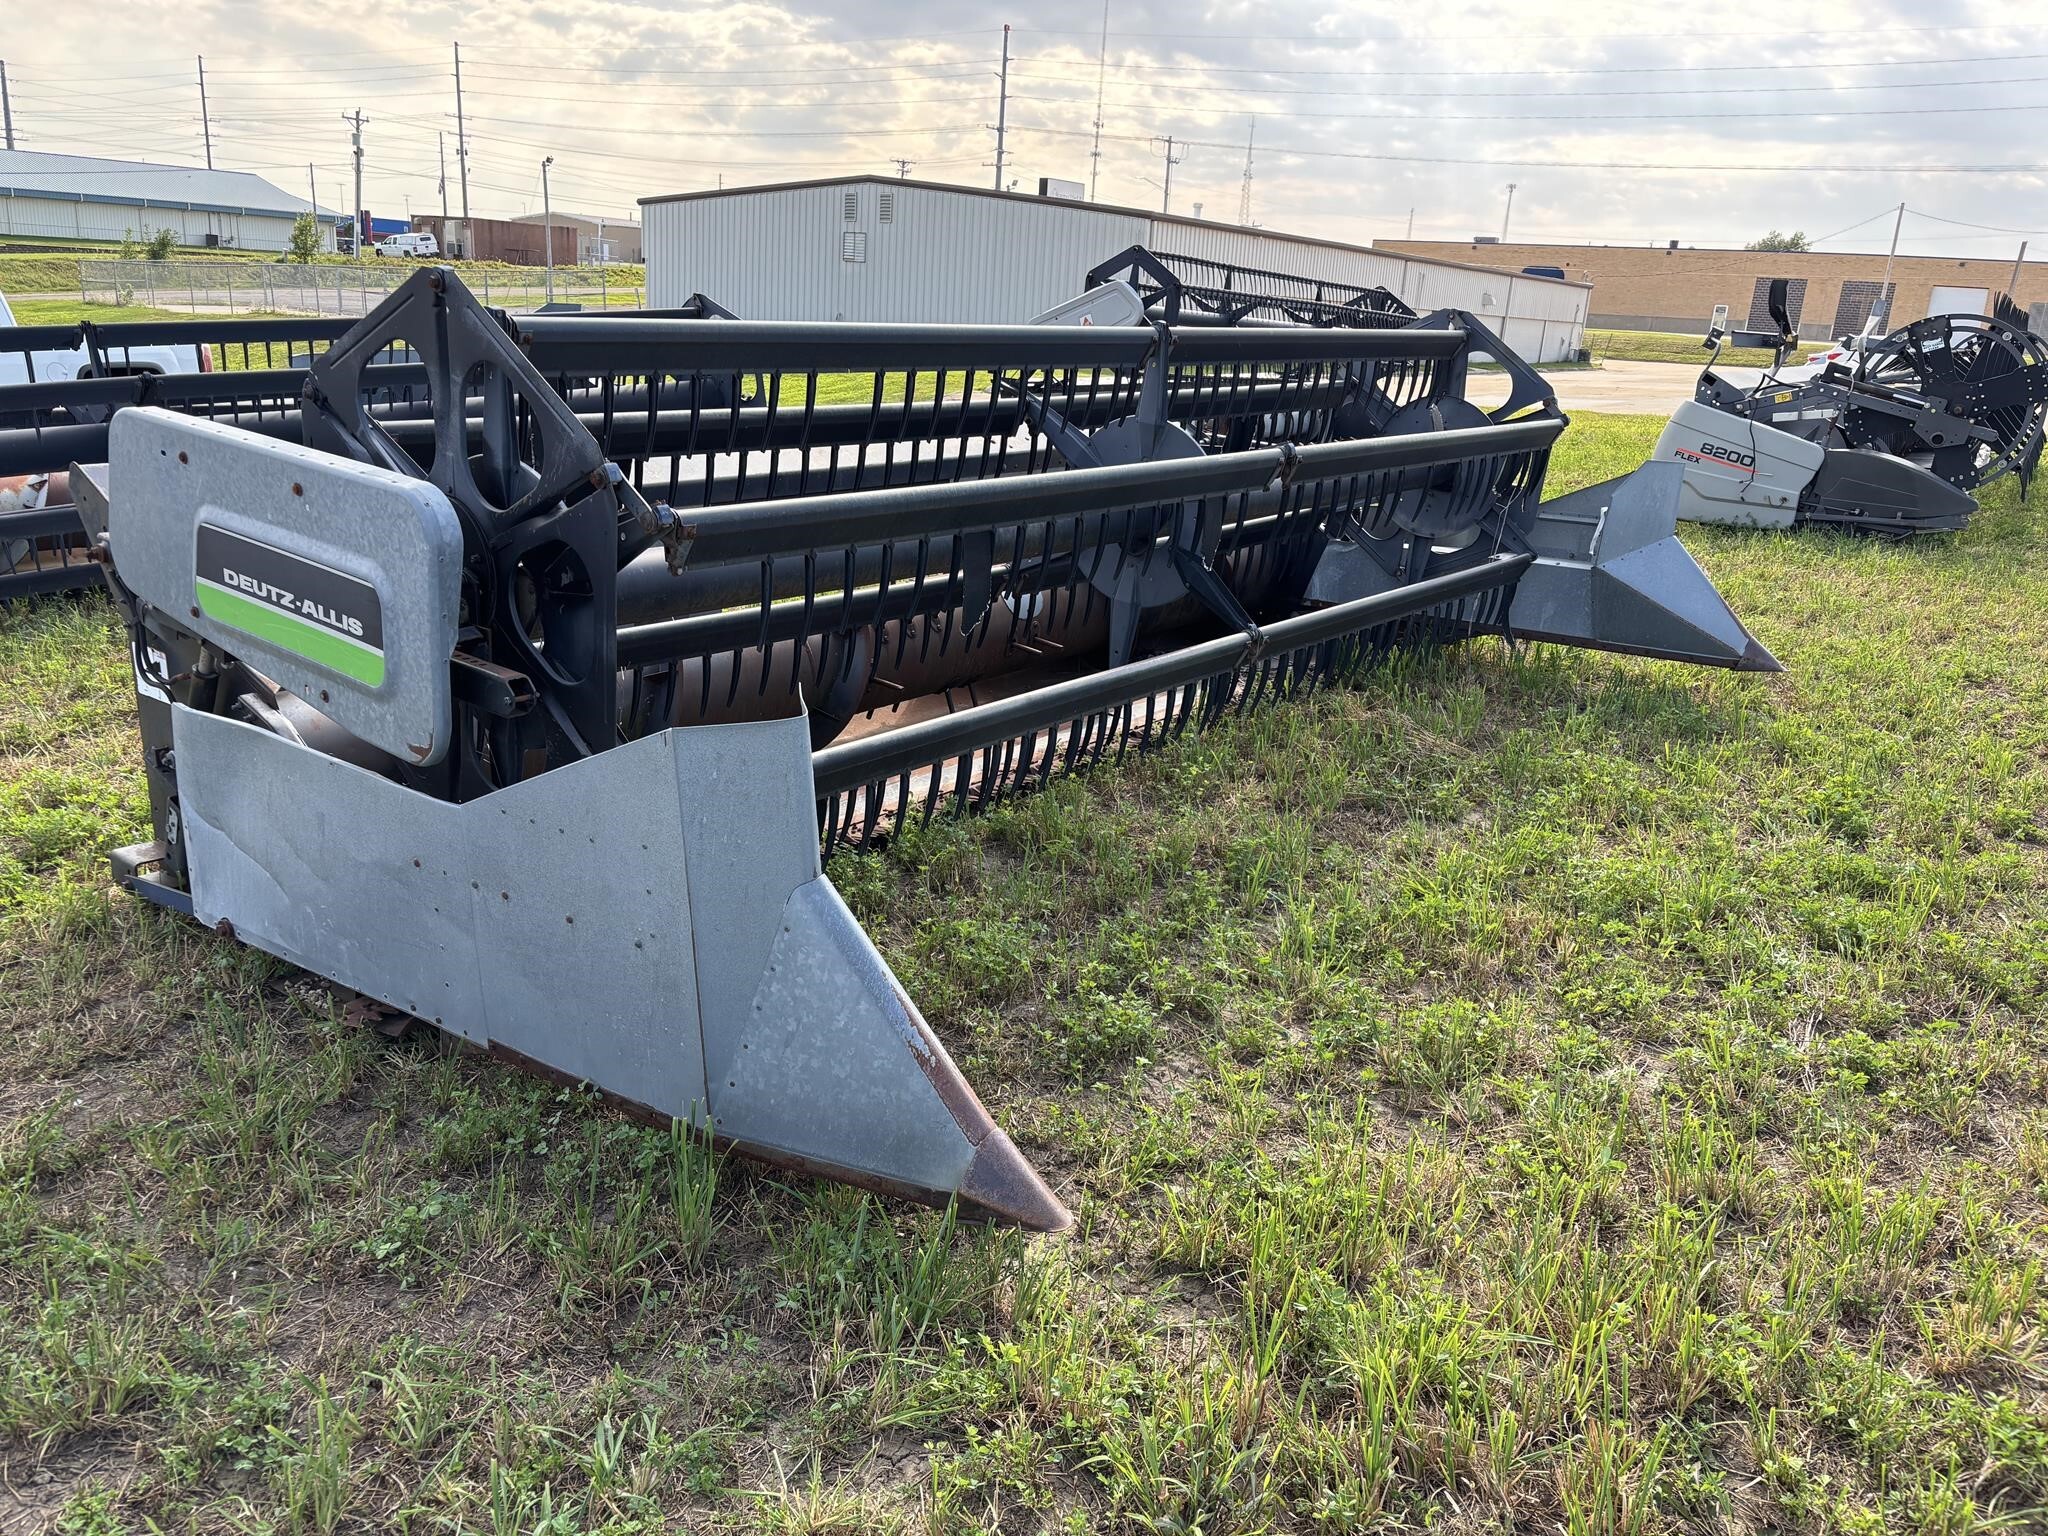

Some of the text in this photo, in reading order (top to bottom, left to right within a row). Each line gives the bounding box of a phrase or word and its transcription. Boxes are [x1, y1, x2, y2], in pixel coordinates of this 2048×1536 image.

[1674, 450, 1701, 464] FLEX
[1700, 442, 1755, 467] 8200
[223, 568, 364, 637] DEUTZ-ALLIS
